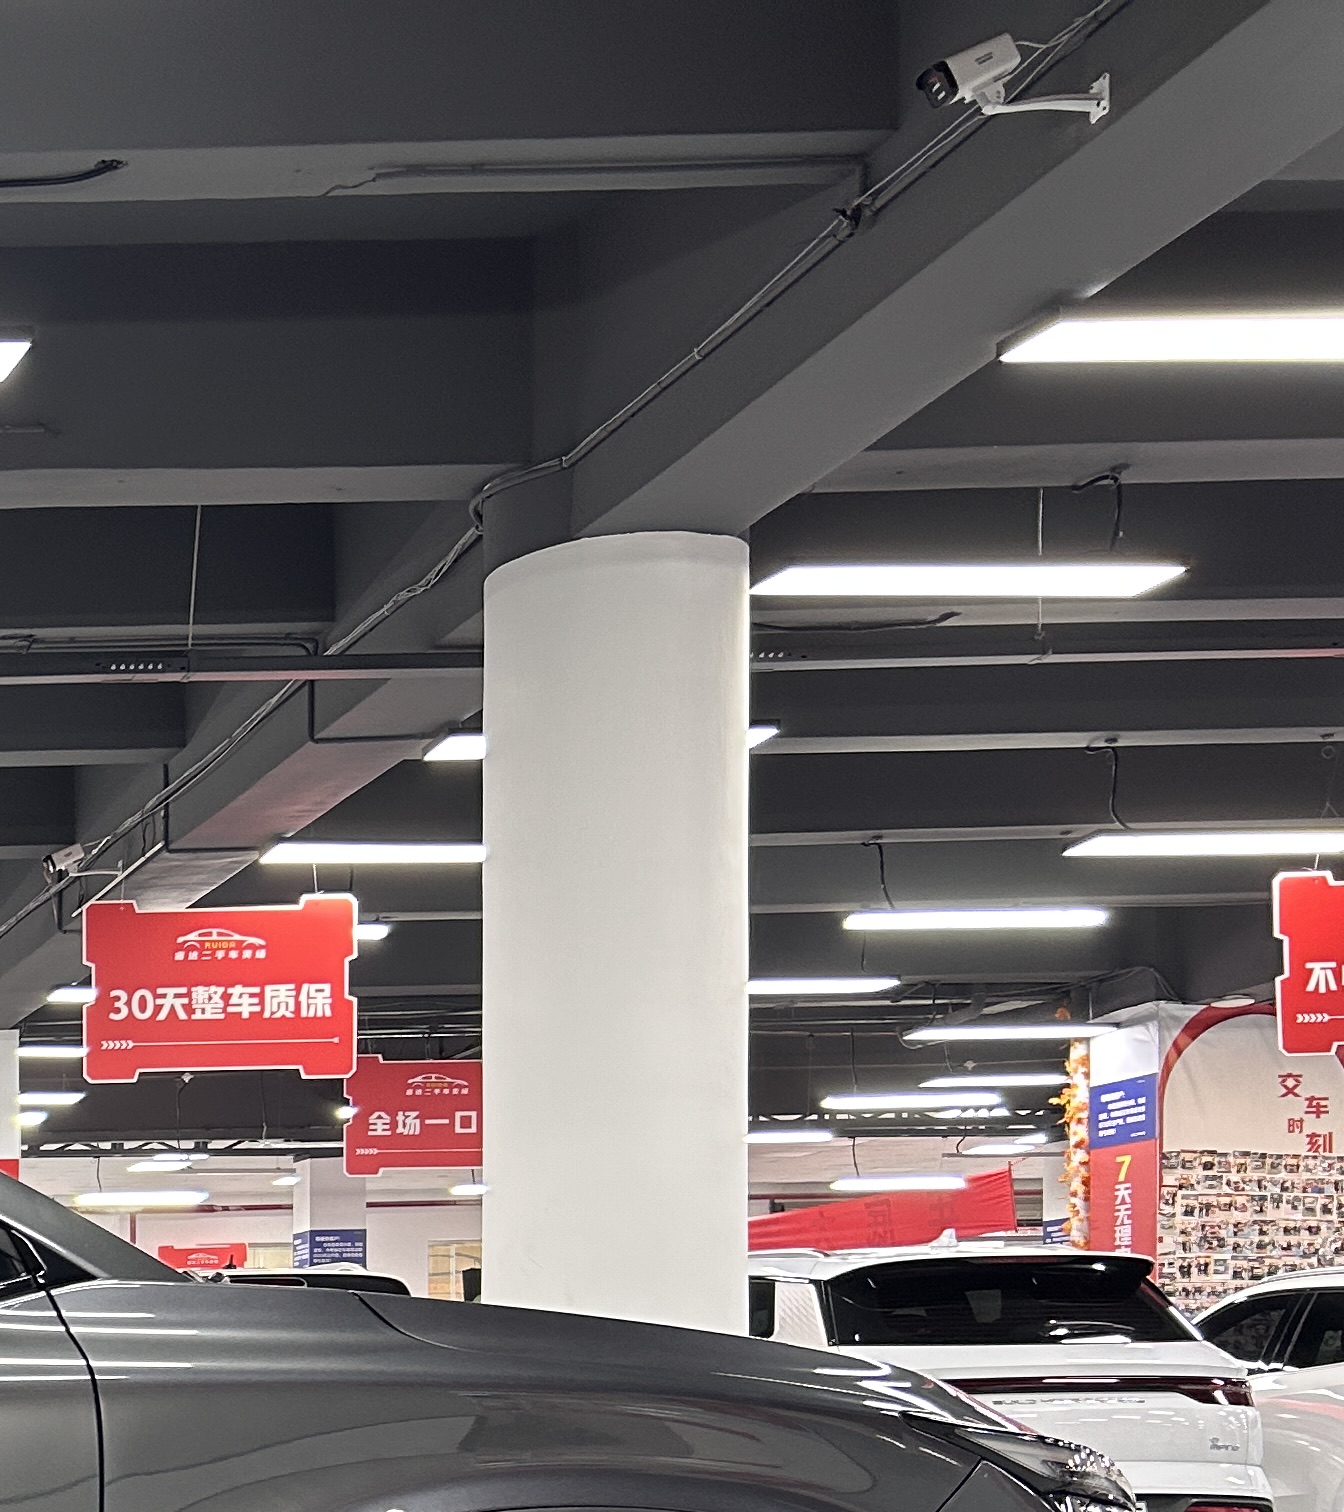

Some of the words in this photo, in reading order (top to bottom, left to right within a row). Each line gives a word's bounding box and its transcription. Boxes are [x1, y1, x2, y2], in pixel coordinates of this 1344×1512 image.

[108, 984, 332, 1021] 30天整车质保
[367, 1110, 478, 1136] 全场一口
